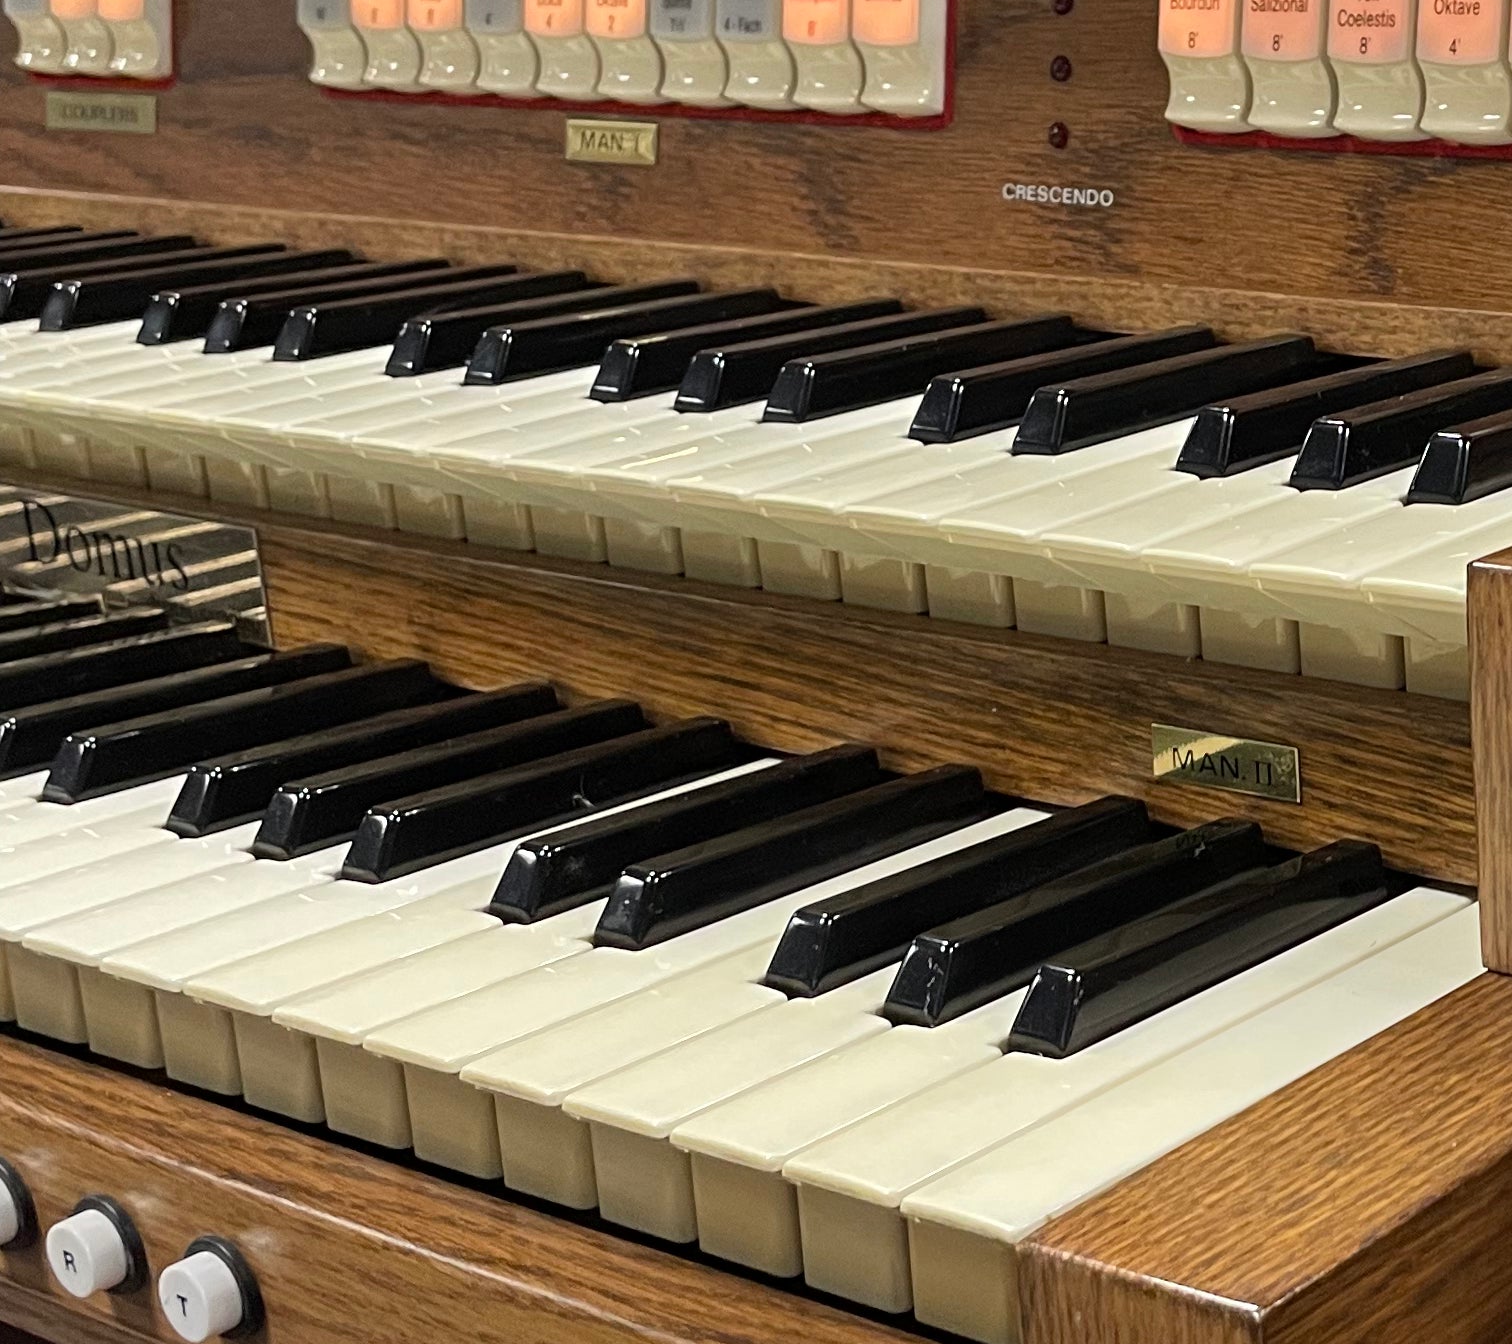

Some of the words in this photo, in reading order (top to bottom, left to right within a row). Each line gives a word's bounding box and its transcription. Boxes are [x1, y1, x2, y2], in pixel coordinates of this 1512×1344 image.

[1337, 8, 1396, 28] Coelestis
[1002, 182, 1114, 207] CRESCENDO
[19, 499, 189, 590] Domus
[1172, 747, 1247, 780] MAN.
[63, 1249, 77, 1273] R
[176, 1294, 189, 1318] T
